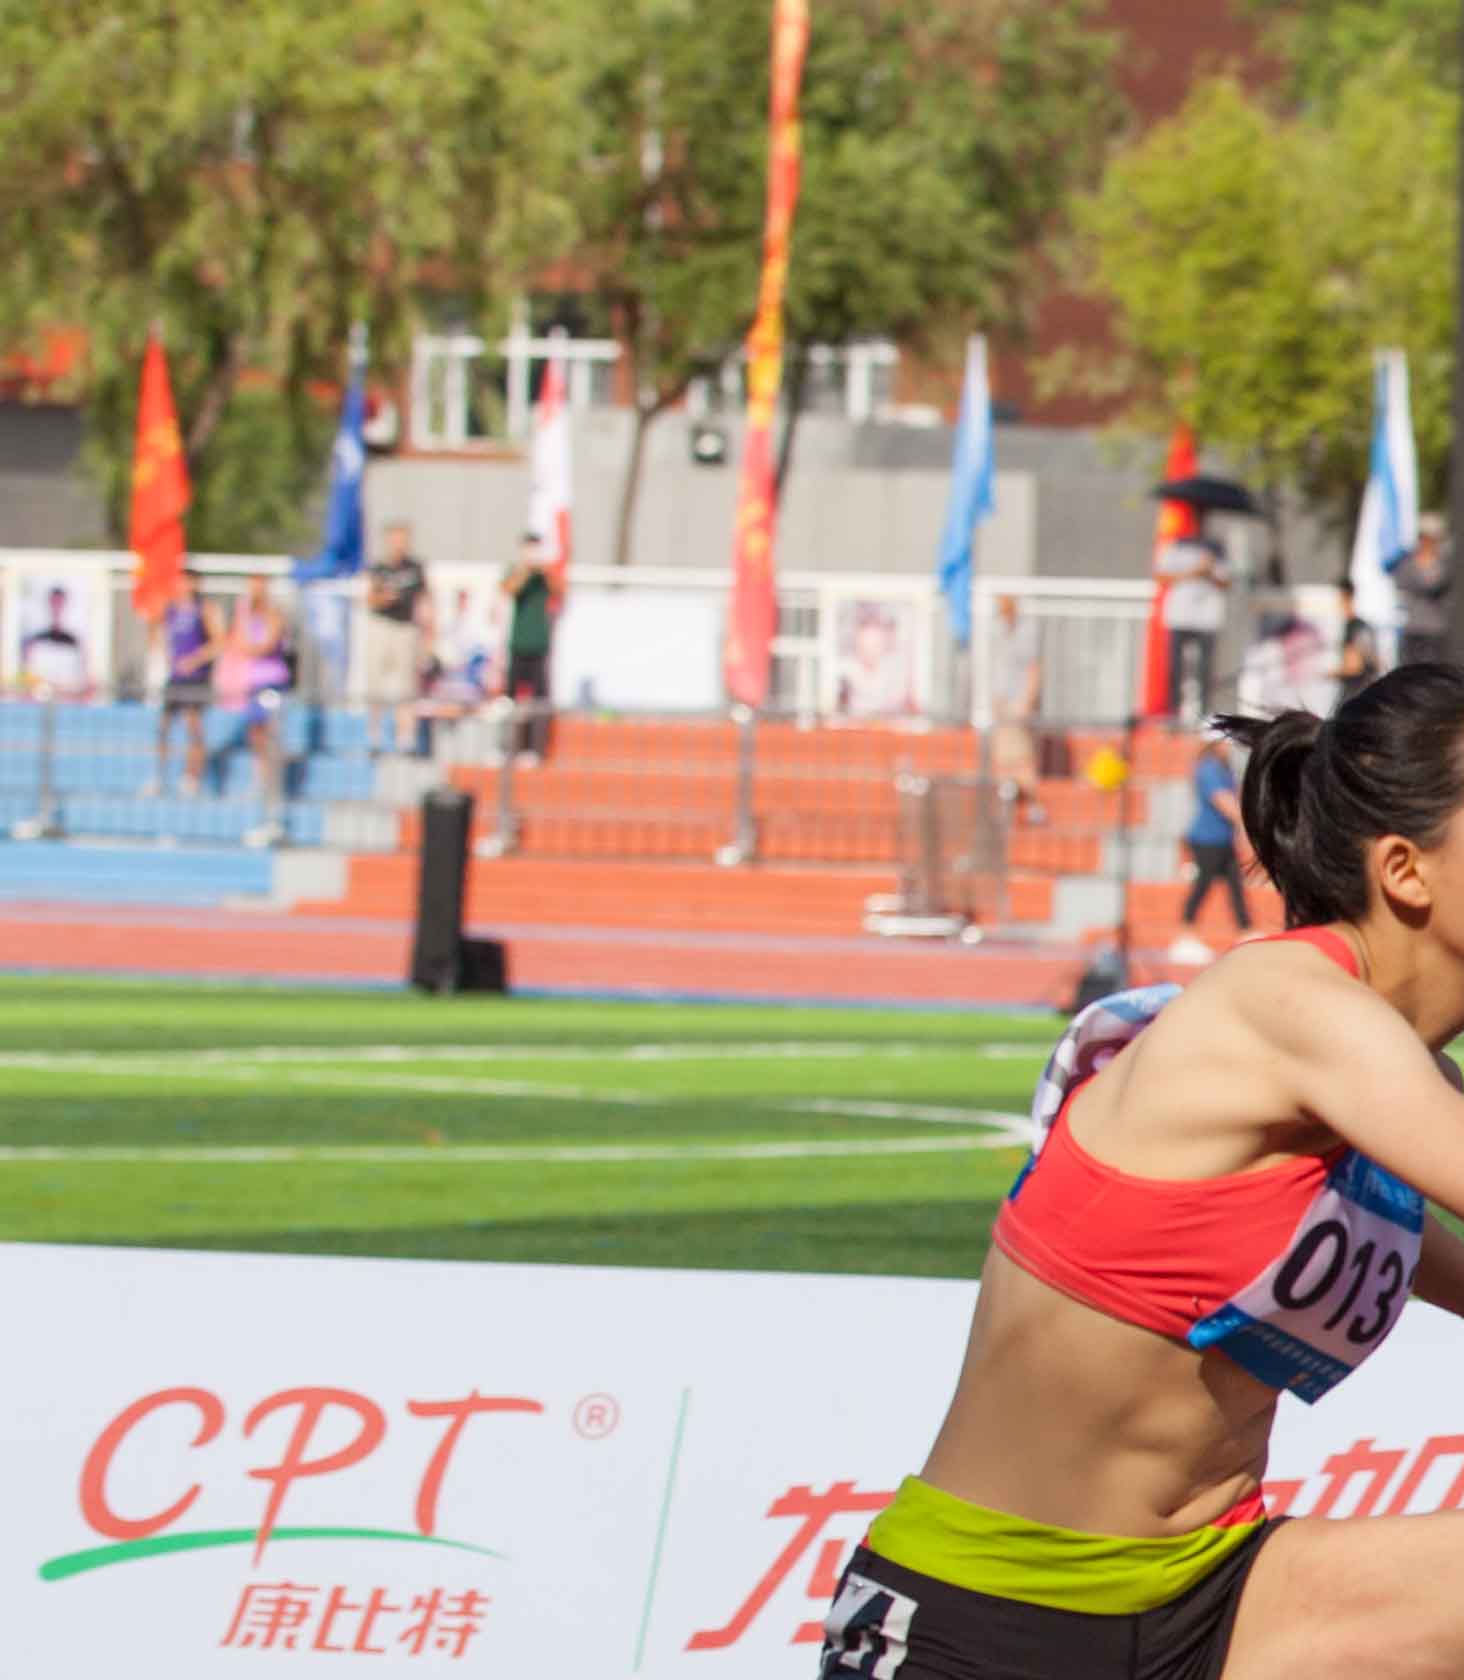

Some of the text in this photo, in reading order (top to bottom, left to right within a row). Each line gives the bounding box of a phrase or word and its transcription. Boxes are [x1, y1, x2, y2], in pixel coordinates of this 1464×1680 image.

[1273, 1220, 1416, 1343] 013
[80, 1388, 543, 1566] CPT
[222, 1581, 489, 1658] 康比特
